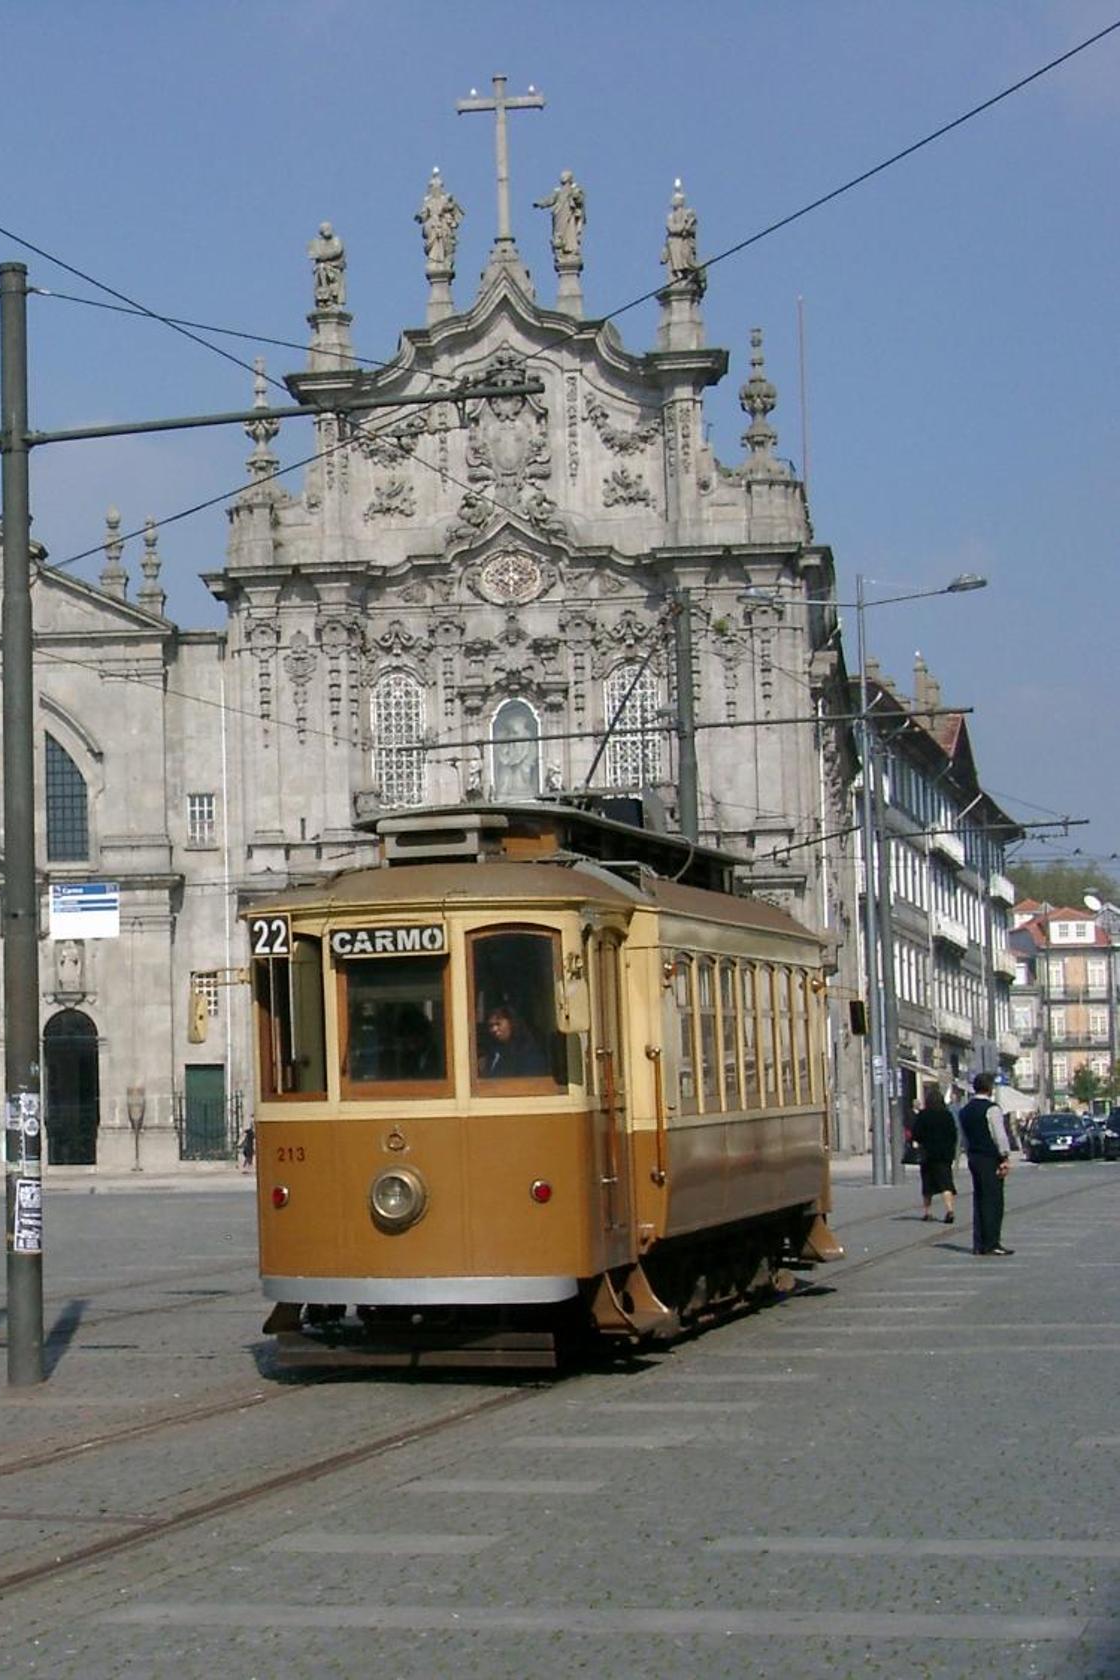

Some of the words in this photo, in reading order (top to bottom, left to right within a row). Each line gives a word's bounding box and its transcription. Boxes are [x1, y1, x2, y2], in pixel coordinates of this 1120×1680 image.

[253, 920, 288, 954] 22
[332, 927, 443, 954] CARMO
[276, 1146, 305, 1162] 213
